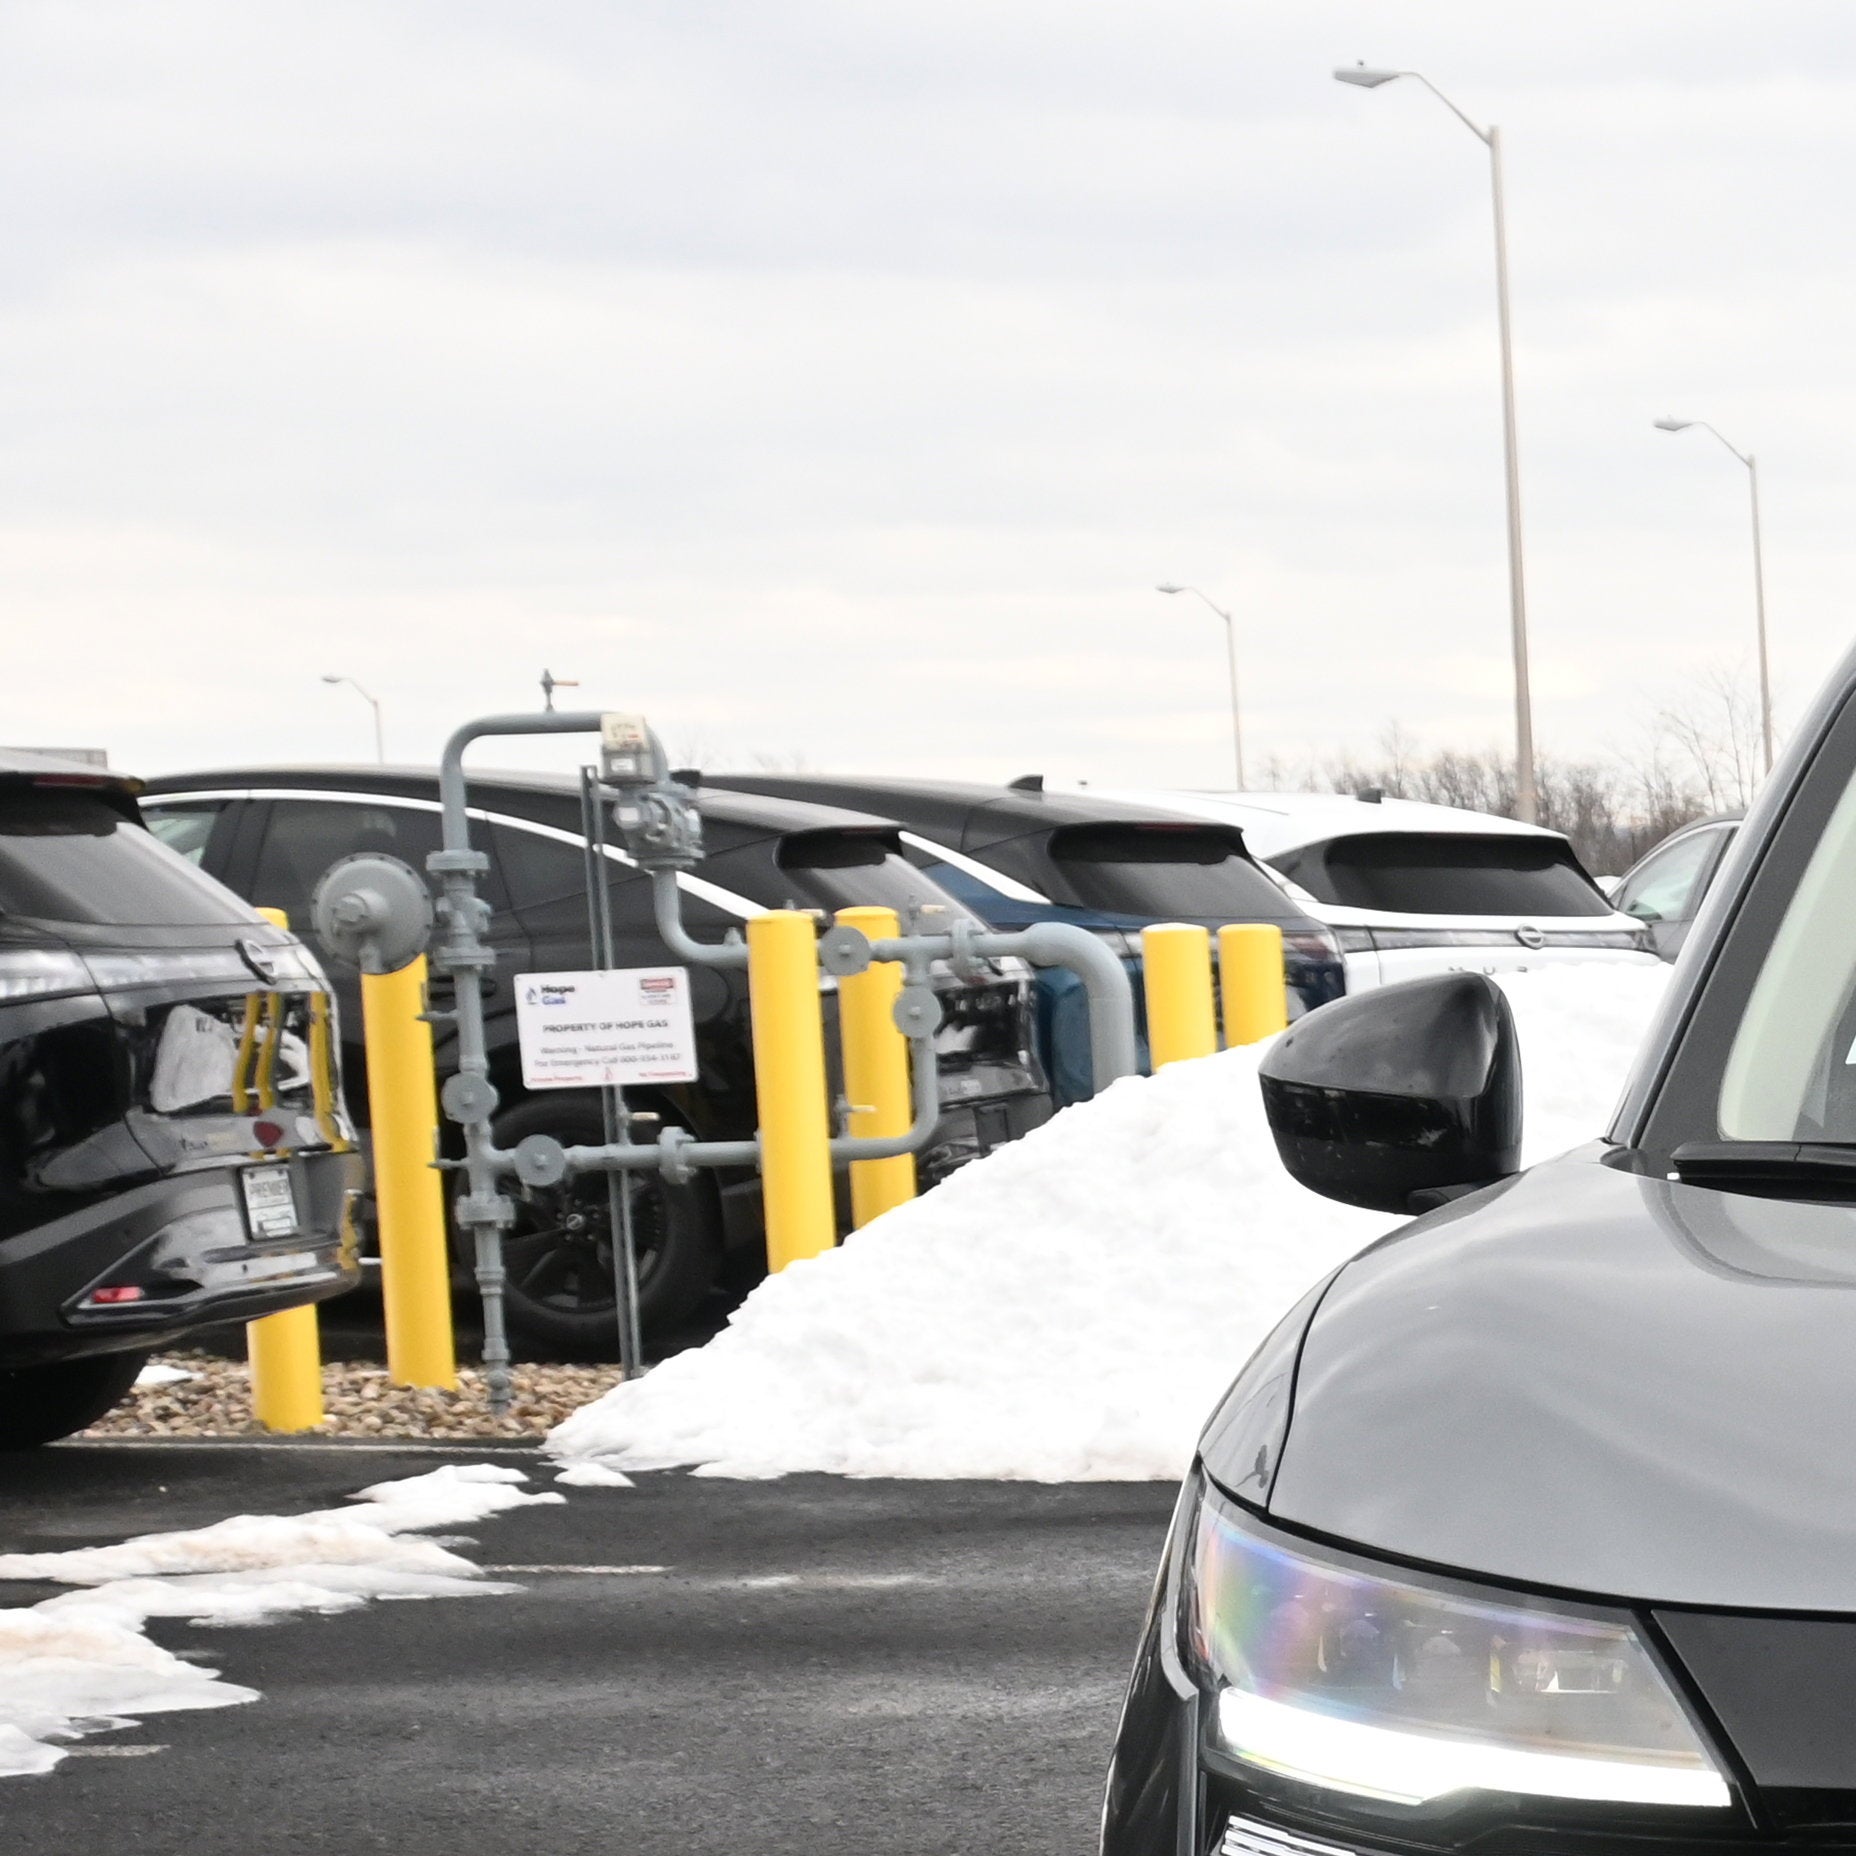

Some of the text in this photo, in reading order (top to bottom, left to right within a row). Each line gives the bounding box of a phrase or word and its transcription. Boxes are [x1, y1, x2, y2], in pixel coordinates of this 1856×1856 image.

[541, 984, 576, 994] Hope
[542, 1019, 669, 1033] PROPERTY OF HOPE GAS
